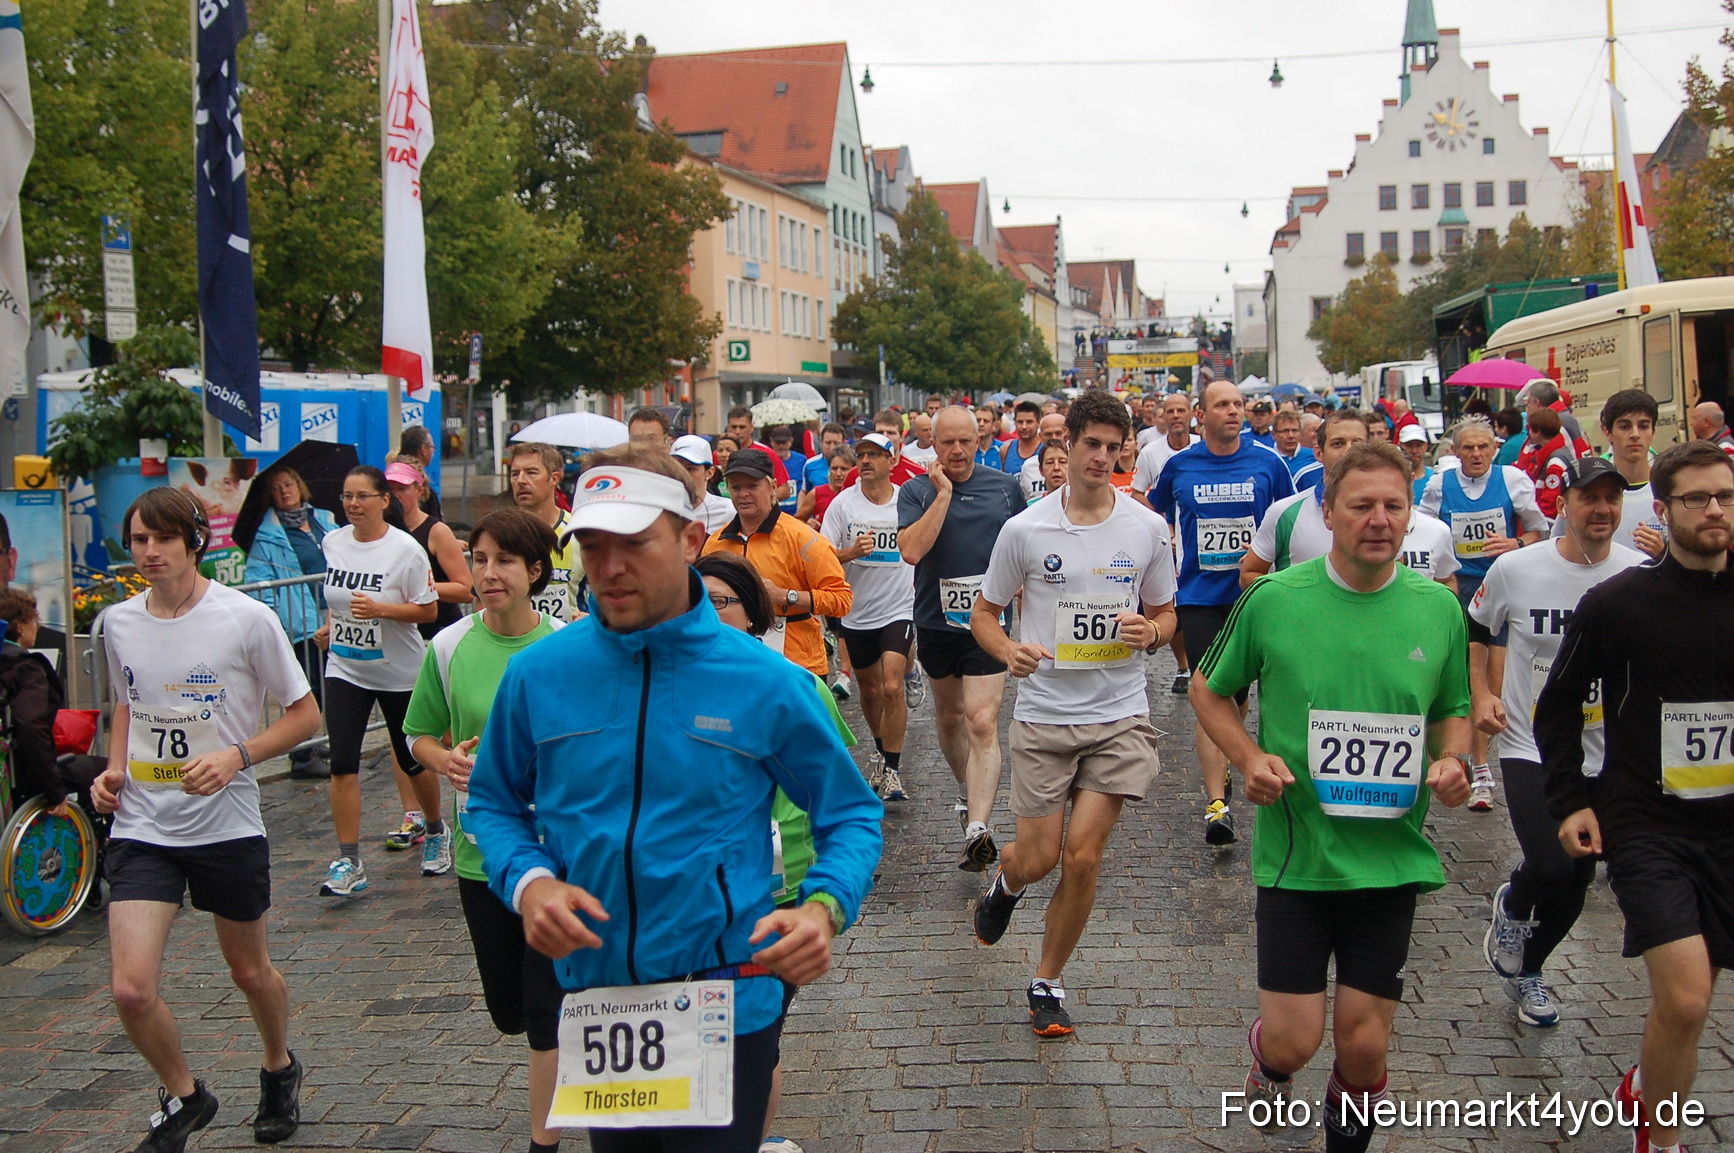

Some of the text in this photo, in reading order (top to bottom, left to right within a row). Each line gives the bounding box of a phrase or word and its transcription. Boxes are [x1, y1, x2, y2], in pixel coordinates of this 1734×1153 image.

[731, 343, 746, 359] D
[1137, 356, 1168, 364] START
[1566, 337, 1615, 364] Bayerisches
[1566, 367, 1588, 384] Rotes
[1569, 391, 1588, 408] reuz
[1193, 483, 1254, 497] HUBER
[1204, 530, 1251, 550] 2769
[326, 567, 383, 592] THULE
[1058, 601, 1123, 610] PARTL Neumarkt
[335, 623, 376, 647] 2424
[1073, 613, 1119, 641] 567
[132, 711, 197, 724] PARTL Neumarkt
[1664, 713, 1701, 722] PARTL
[1311, 721, 1404, 735] PARTL Neumarkt
[151, 727, 189, 759] 78
[1686, 726, 1734, 762] 57
[1320, 737, 1412, 778] 2872
[1330, 785, 1398, 806] Wolfgang
[563, 1000, 668, 1019] PARTL Neumarkt
[583, 1019, 665, 1076] 508
[584, 1088, 658, 1110] Thorsten
